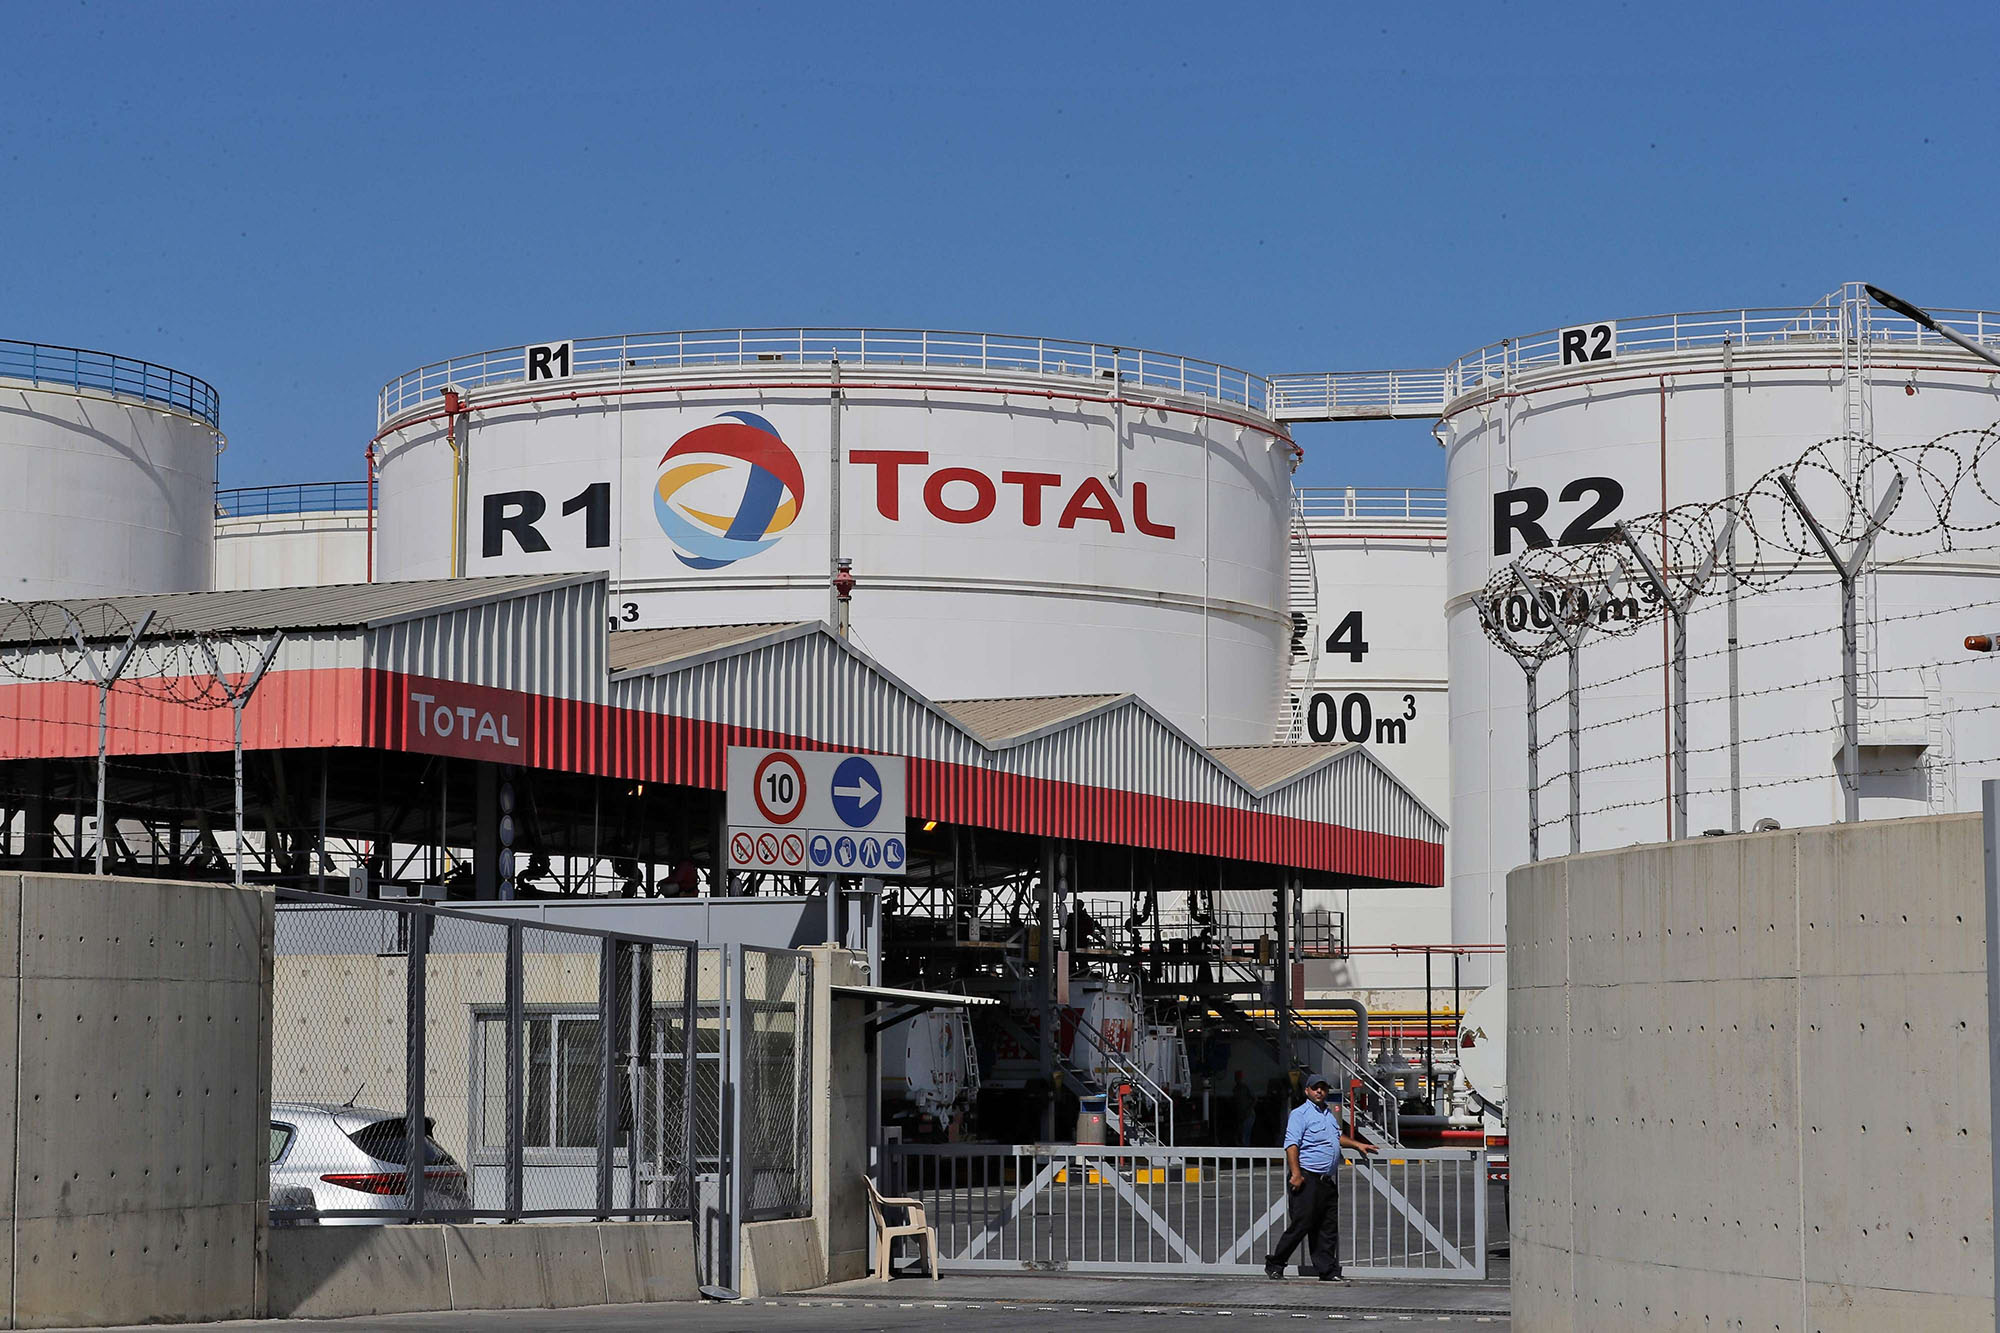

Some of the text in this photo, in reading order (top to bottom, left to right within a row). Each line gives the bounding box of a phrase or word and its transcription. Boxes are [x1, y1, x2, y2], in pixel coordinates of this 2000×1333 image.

[529, 344, 570, 381] R1
[1563, 325, 1612, 365] R2
[849, 450, 1176, 539] TOTAL
[1493, 477, 1624, 556] R2
[482, 483, 611, 558] R1
[411, 692, 519, 747] TOTAL
[766, 773, 794, 804] 10
[355, 877, 363, 893] D
